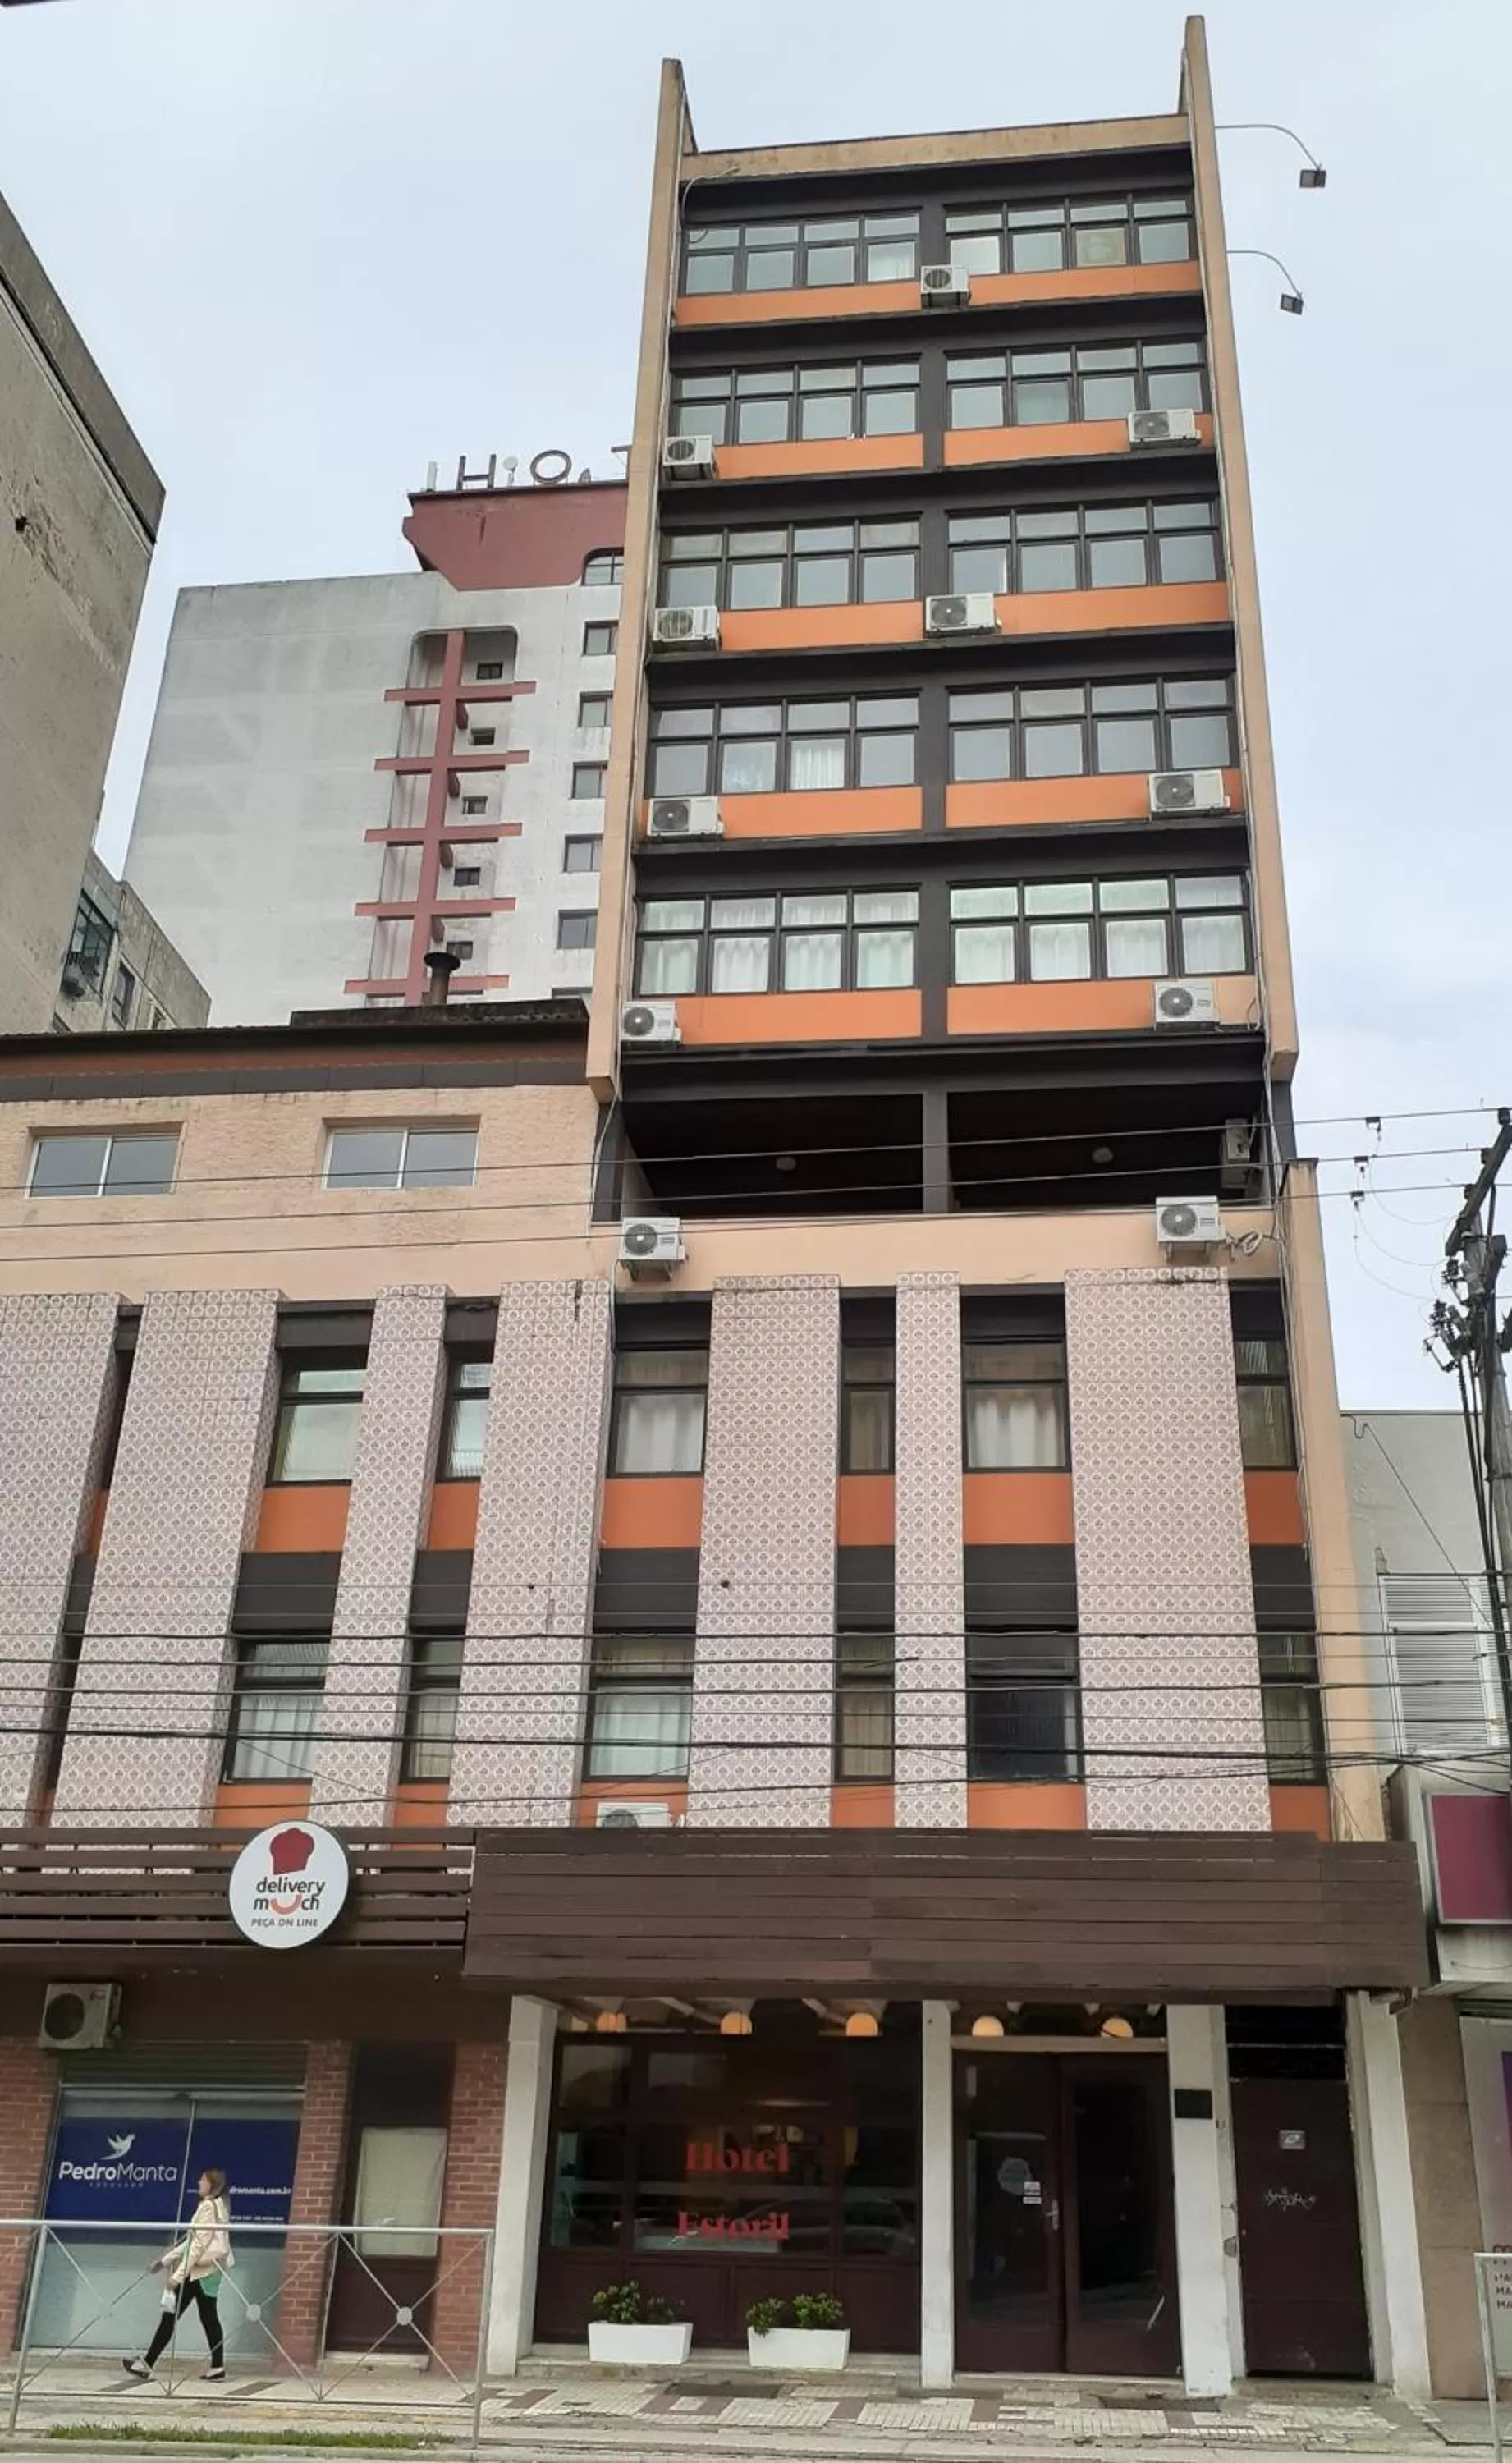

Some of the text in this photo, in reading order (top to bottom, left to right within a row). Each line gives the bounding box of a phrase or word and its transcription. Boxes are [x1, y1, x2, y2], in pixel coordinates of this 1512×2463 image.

[256, 1876, 326, 1897] delivery
[253, 1894, 320, 1915] much
[250, 1918, 319, 1928] PEÇA ON LINE
[685, 2142, 790, 2172] Hotel
[58, 2161, 178, 2181] PedroManta
[677, 2210, 790, 2241] Estoril
